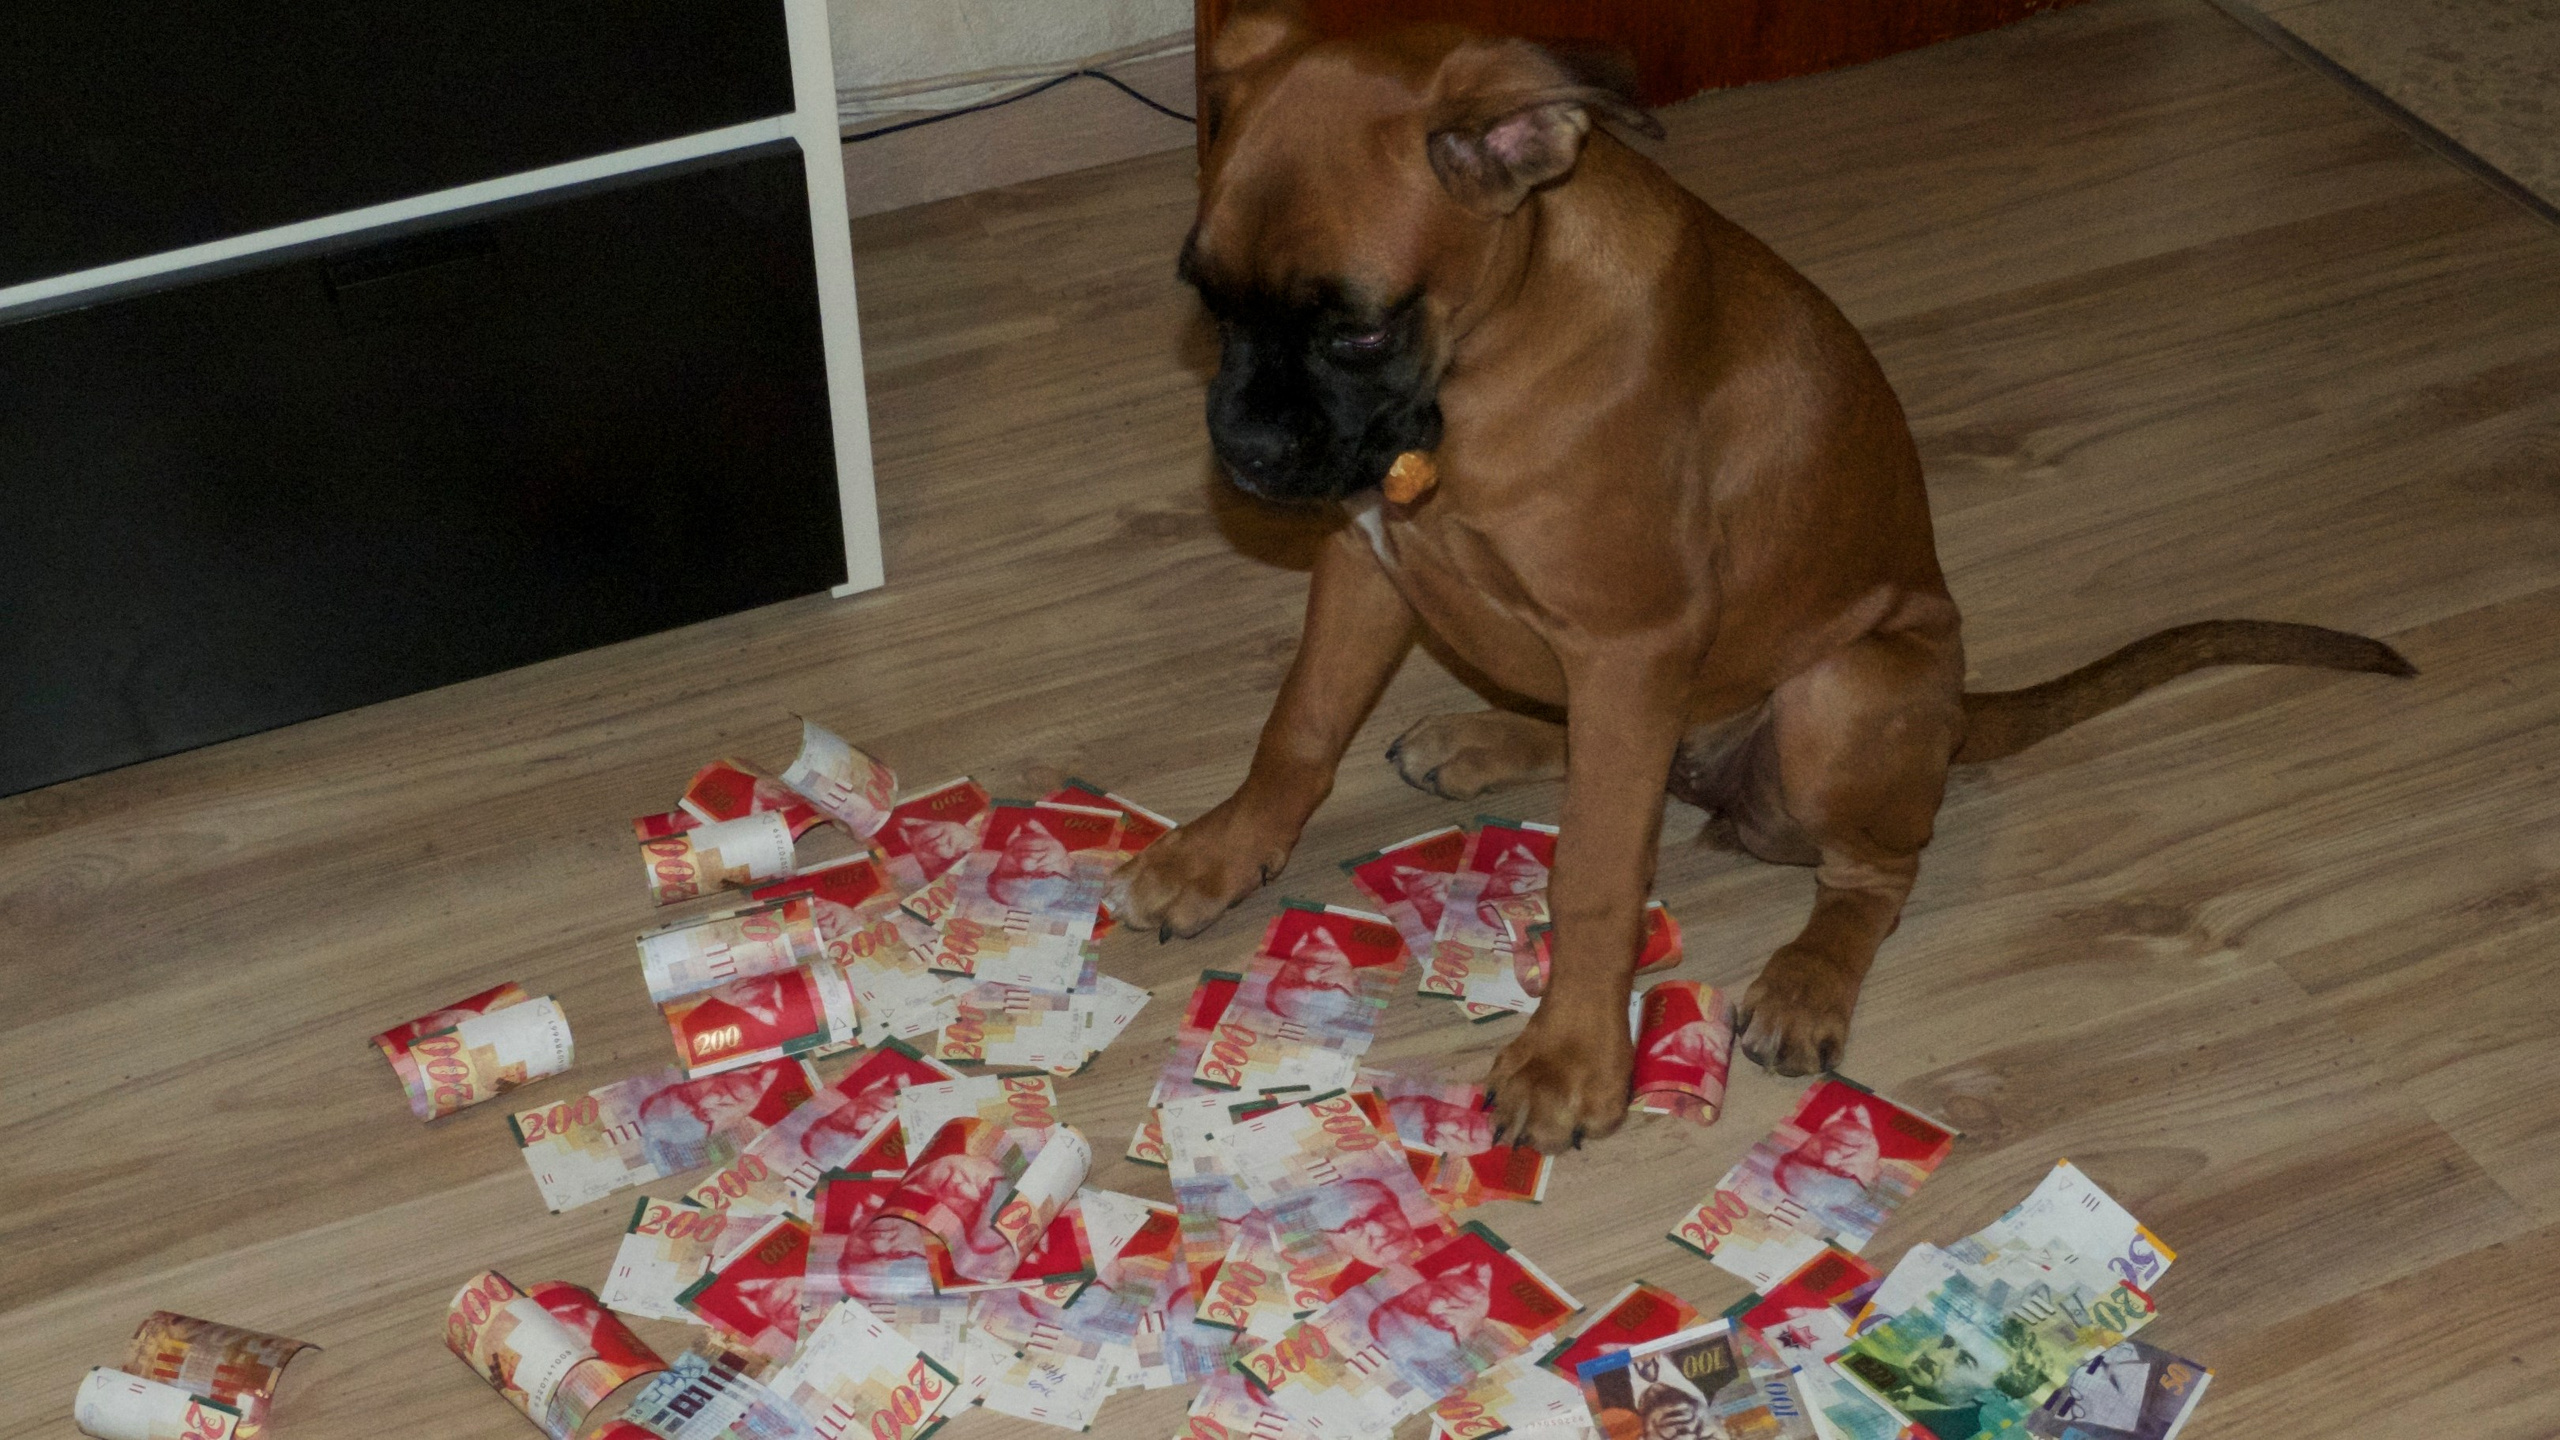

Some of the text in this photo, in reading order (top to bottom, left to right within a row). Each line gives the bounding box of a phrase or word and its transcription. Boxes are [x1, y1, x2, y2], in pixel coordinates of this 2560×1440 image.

[827, 920, 898, 967] 200
[936, 918, 984, 974] 200
[1427, 940, 1474, 996] 200
[693, 1024, 741, 1056] 200
[943, 1002, 988, 1060] 200
[1203, 1023, 1257, 1087] 200
[417, 1036, 474, 1106] 200
[521, 1095, 598, 1143] 200
[1003, 1077, 1055, 1129] 200
[1307, 1097, 1379, 1150] 200
[697, 1153, 768, 1210] 200
[636, 1205, 728, 1242] 200
[1681, 1189, 1749, 1254] 200
[448, 1274, 514, 1355] 200
[1207, 1261, 1267, 1332] 200
[2093, 1286, 2149, 1333] 20
[1251, 1324, 1330, 1390] 200
[1683, 1347, 1729, 1379] 100
[2159, 1363, 2191, 1396] 50
[1764, 1382, 1799, 1417] 100
